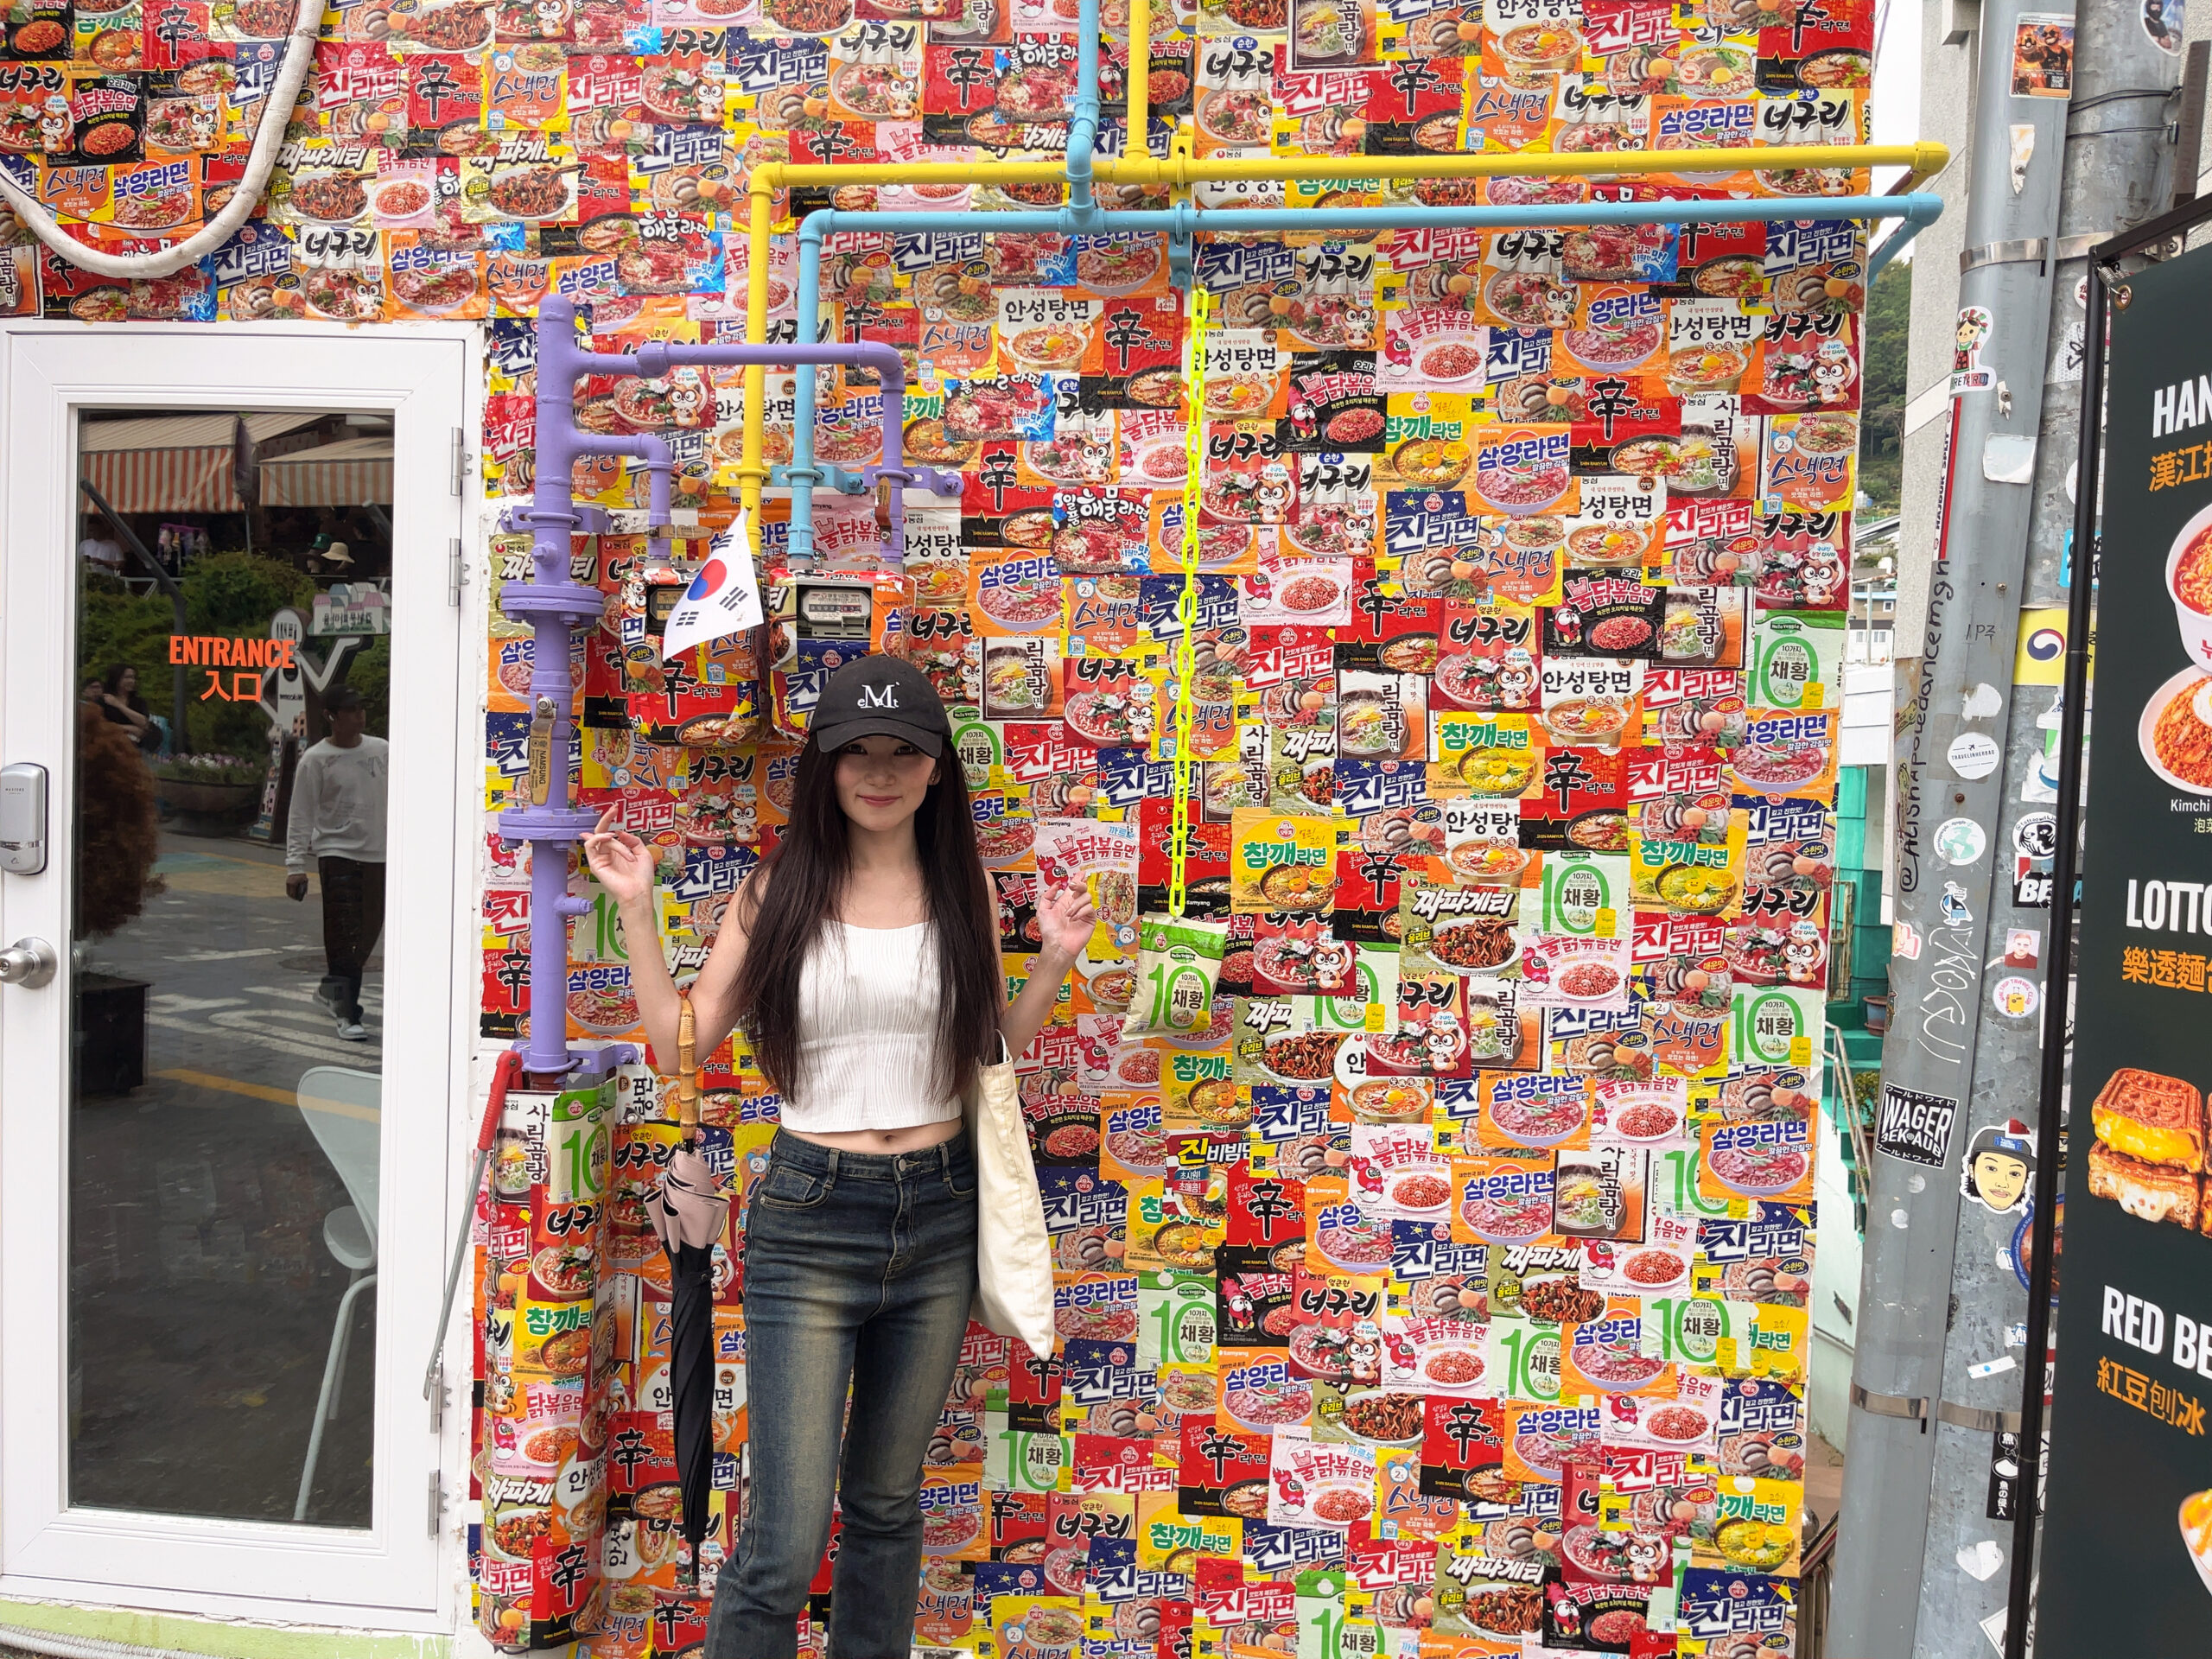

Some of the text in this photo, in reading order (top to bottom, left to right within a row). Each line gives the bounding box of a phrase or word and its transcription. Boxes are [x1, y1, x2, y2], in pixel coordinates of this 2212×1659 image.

[156, 3, 199, 64] 辛
[1820, 20, 1851, 33] 라면
[1236, 37, 1254, 49] 순한
[741, 50, 830, 93] 진라면
[947, 48, 993, 107] 辛
[320, 67, 399, 109] 진라면
[417, 61, 459, 122] 辛
[493, 74, 557, 105] 스낵면
[1393, 60, 1439, 115] 辛
[1433, 82, 1460, 94] 라면
[1473, 91, 1548, 122] 스낵면
[1764, 97, 1849, 130] 너구리
[848, 145, 874, 158] 라면
[46, 165, 106, 196] 스낵면
[114, 160, 189, 197] 삼양라면
[704, 167, 727, 180] 순한맛
[270, 180, 292, 196] 올리브
[467, 182, 488, 196] 올리브
[594, 188, 619, 199] 라면
[638, 210, 711, 239] 해물라면
[1714, 226, 1745, 239] 라면
[306, 231, 377, 257] 너구리
[218, 244, 293, 287] 진라면
[865, 253, 889, 267] 매운맛
[965, 263, 988, 276] 순한맛
[1834, 266, 1856, 278] 순한맛
[1204, 252, 1295, 296] 진라면
[1277, 283, 1299, 296] 순한맛
[878, 317, 903, 329] 라면
[1005, 299, 1090, 321] 안성탕면
[924, 325, 989, 353] 스낵면
[1105, 308, 1150, 370] 辛
[1145, 338, 1172, 351] 라면
[1060, 379, 1078, 392] 순한
[1588, 378, 1636, 441] 辛
[1630, 409, 1659, 419] 라면
[1478, 434, 1569, 469] 삼양라면
[1711, 397, 1739, 490] 사리곰탕면
[685, 463, 706, 476] 순한맛
[981, 450, 1017, 511] 辛
[1770, 456, 1845, 486] 스낵면
[1082, 489, 1150, 520] 해물라면
[1386, 513, 1480, 556] 진라면
[1665, 505, 1751, 550] 진라면
[1459, 549, 1480, 560] 순한맛
[1732, 538, 1755, 551] 매운맛
[1488, 551, 1553, 578] 스낵면
[1567, 576, 1657, 610] 불닭볶음면
[1399, 604, 1427, 617] 라면
[1224, 630, 1243, 643] 순한맛
[1449, 616, 1530, 647] 너구리
[169, 636, 295, 668] ENTRANCE
[630, 648, 652, 660] 순한맛
[1245, 646, 1333, 691] 진라면
[1542, 668, 1630, 693] 안성탕면
[1770, 660, 1808, 680] 채황
[200, 671, 262, 702] 入口
[693, 685, 721, 697] 라면
[1719, 699, 1740, 711] 매운맛
[1441, 723, 1528, 750] 참깨라면
[538, 750, 548, 785] NAMSUNG
[958, 748, 993, 765] 채황
[1279, 773, 1300, 787] 올리브
[1545, 751, 1592, 812] 辛
[1585, 782, 1615, 794] 라면
[1628, 760, 1721, 804] 진라면
[1417, 810, 1439, 821] 순한맛
[1700, 797, 1723, 808] 매운맛
[2171, 799, 2209, 812] Kimchi
[1052, 833, 1139, 867] 불닭볶음면
[1200, 850, 1227, 862] 라면
[1243, 842, 1327, 868] 참깨라면
[1802, 845, 1825, 856] 순한맛
[1413, 889, 1516, 925] 짜파게티
[1541, 864, 1609, 933] 10
[1563, 887, 1600, 906] 채황
[1408, 931, 1431, 945] 올리브
[1632, 926, 1724, 965] 진라면
[1703, 960, 1725, 971] 매운맛
[2122, 946, 2212, 992] 樂透麵
[1148, 963, 1211, 1028] 10
[1173, 988, 1204, 1008] 채황
[1653, 1020, 1719, 1048] 스낵면
[1732, 993, 1803, 1063] 10
[1757, 1016, 1795, 1035] 채황
[1240, 1041, 1263, 1054] 올리브
[1622, 1034, 1643, 1046] 순한맛
[703, 1064, 731, 1074] 라면
[1779, 1075, 1800, 1087] 순한맛
[1886, 1085, 1955, 1106] ワールドワイド
[1712, 1122, 1807, 1151] 삼양라면
[1882, 1092, 1953, 1154] WAGER
[1876, 1144, 1942, 1166] ワールドワイド
[1911, 1131, 1942, 1158] AUB
[1249, 1179, 1293, 1240] 辛
[1704, 1220, 1804, 1263] 진라면
[1393, 1240, 1488, 1281] 진라면
[1466, 1278, 1487, 1289] 순한맛
[1497, 1286, 1520, 1298] 올리브
[1301, 1289, 1379, 1317] 너구리
[1651, 1298, 1728, 1363] 10
[2102, 1284, 2164, 1355] RED
[1180, 1324, 1216, 1344] 채황
[987, 1368, 1007, 1379] 매운맛
[1319, 1402, 1344, 1414] 올리브
[2097, 1355, 2206, 1436] 紅豆刨冰
[1446, 1403, 1491, 1462] 辛
[613, 1428, 653, 1487] 辛
[1028, 1445, 1062, 1465] 채황
[1200, 1427, 1246, 1483] 辛
[1295, 1452, 1376, 1481] 불닭볶음면
[1387, 1489, 1455, 1515] 스낵면
[1997, 1480, 2009, 1517] 魚の侵入
[1055, 1513, 1131, 1538] 너구리
[1149, 1522, 1231, 1552] 참깨라면
[553, 1544, 588, 1605] 辛
[1446, 1554, 1545, 1587] 짜파게티
[1207, 1589, 1294, 1630] 진라면
[1440, 1593, 1464, 1605] 올리브
[1341, 1633, 1376, 1652] 채황
